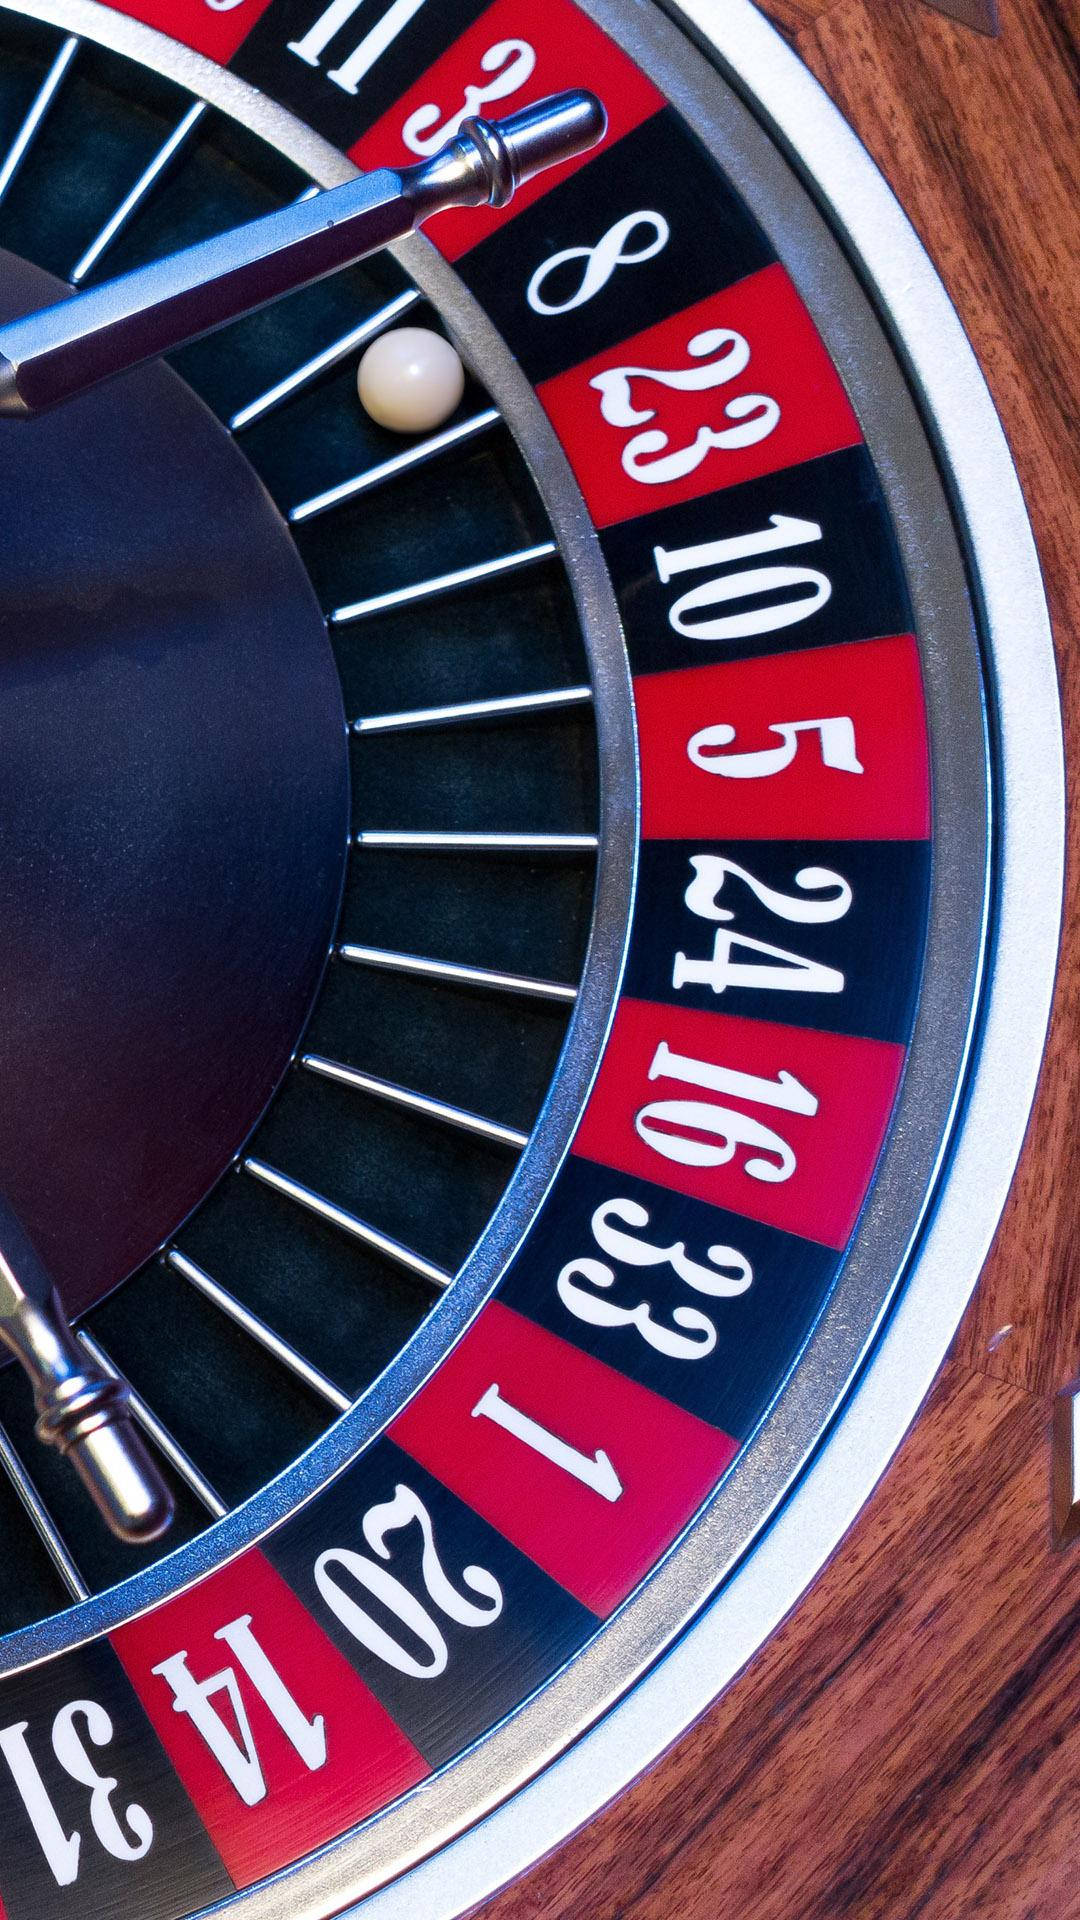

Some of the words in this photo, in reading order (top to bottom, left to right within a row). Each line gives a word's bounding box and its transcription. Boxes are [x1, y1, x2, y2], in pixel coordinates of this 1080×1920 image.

[527, 210, 669, 316] 8
[589, 328, 781, 485] 23
[653, 514, 833, 641] 10
[687, 716, 865, 779] 5
[672, 854, 853, 994] 24
[635, 1041, 819, 1185] 16
[557, 1198, 753, 1360] 33
[471, 1383, 624, 1503] 1
[313, 1483, 504, 1679] 20
[151, 1614, 328, 1807] 14
[0, 1699, 155, 1887] 31
